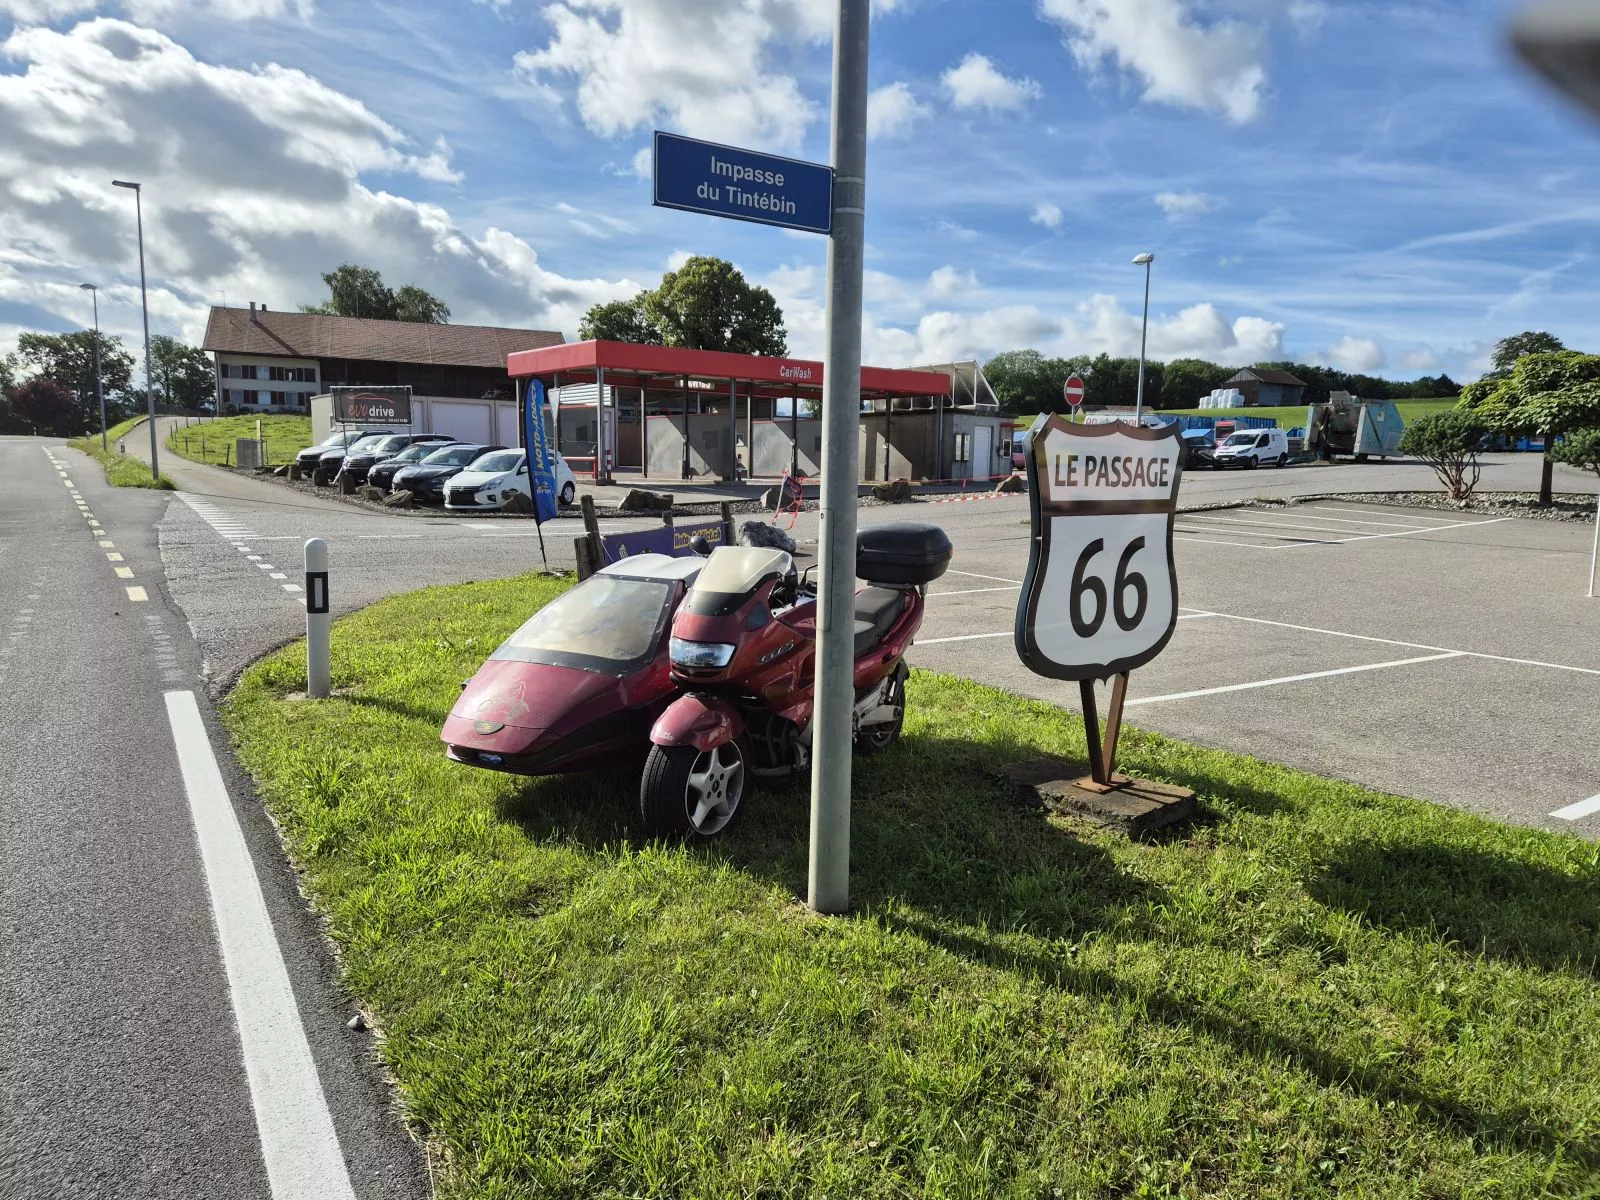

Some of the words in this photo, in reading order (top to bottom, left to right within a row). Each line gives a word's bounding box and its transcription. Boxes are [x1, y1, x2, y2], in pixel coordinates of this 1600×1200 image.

[711, 156, 785, 186] Impasse
[697, 182, 720, 200] du
[726, 186, 796, 214] Tintébin
[780, 365, 812, 379] CarWash
[1055, 455, 1079, 487] LE
[1085, 455, 1170, 488] PASSAGE
[1070, 535, 1149, 639] 66
